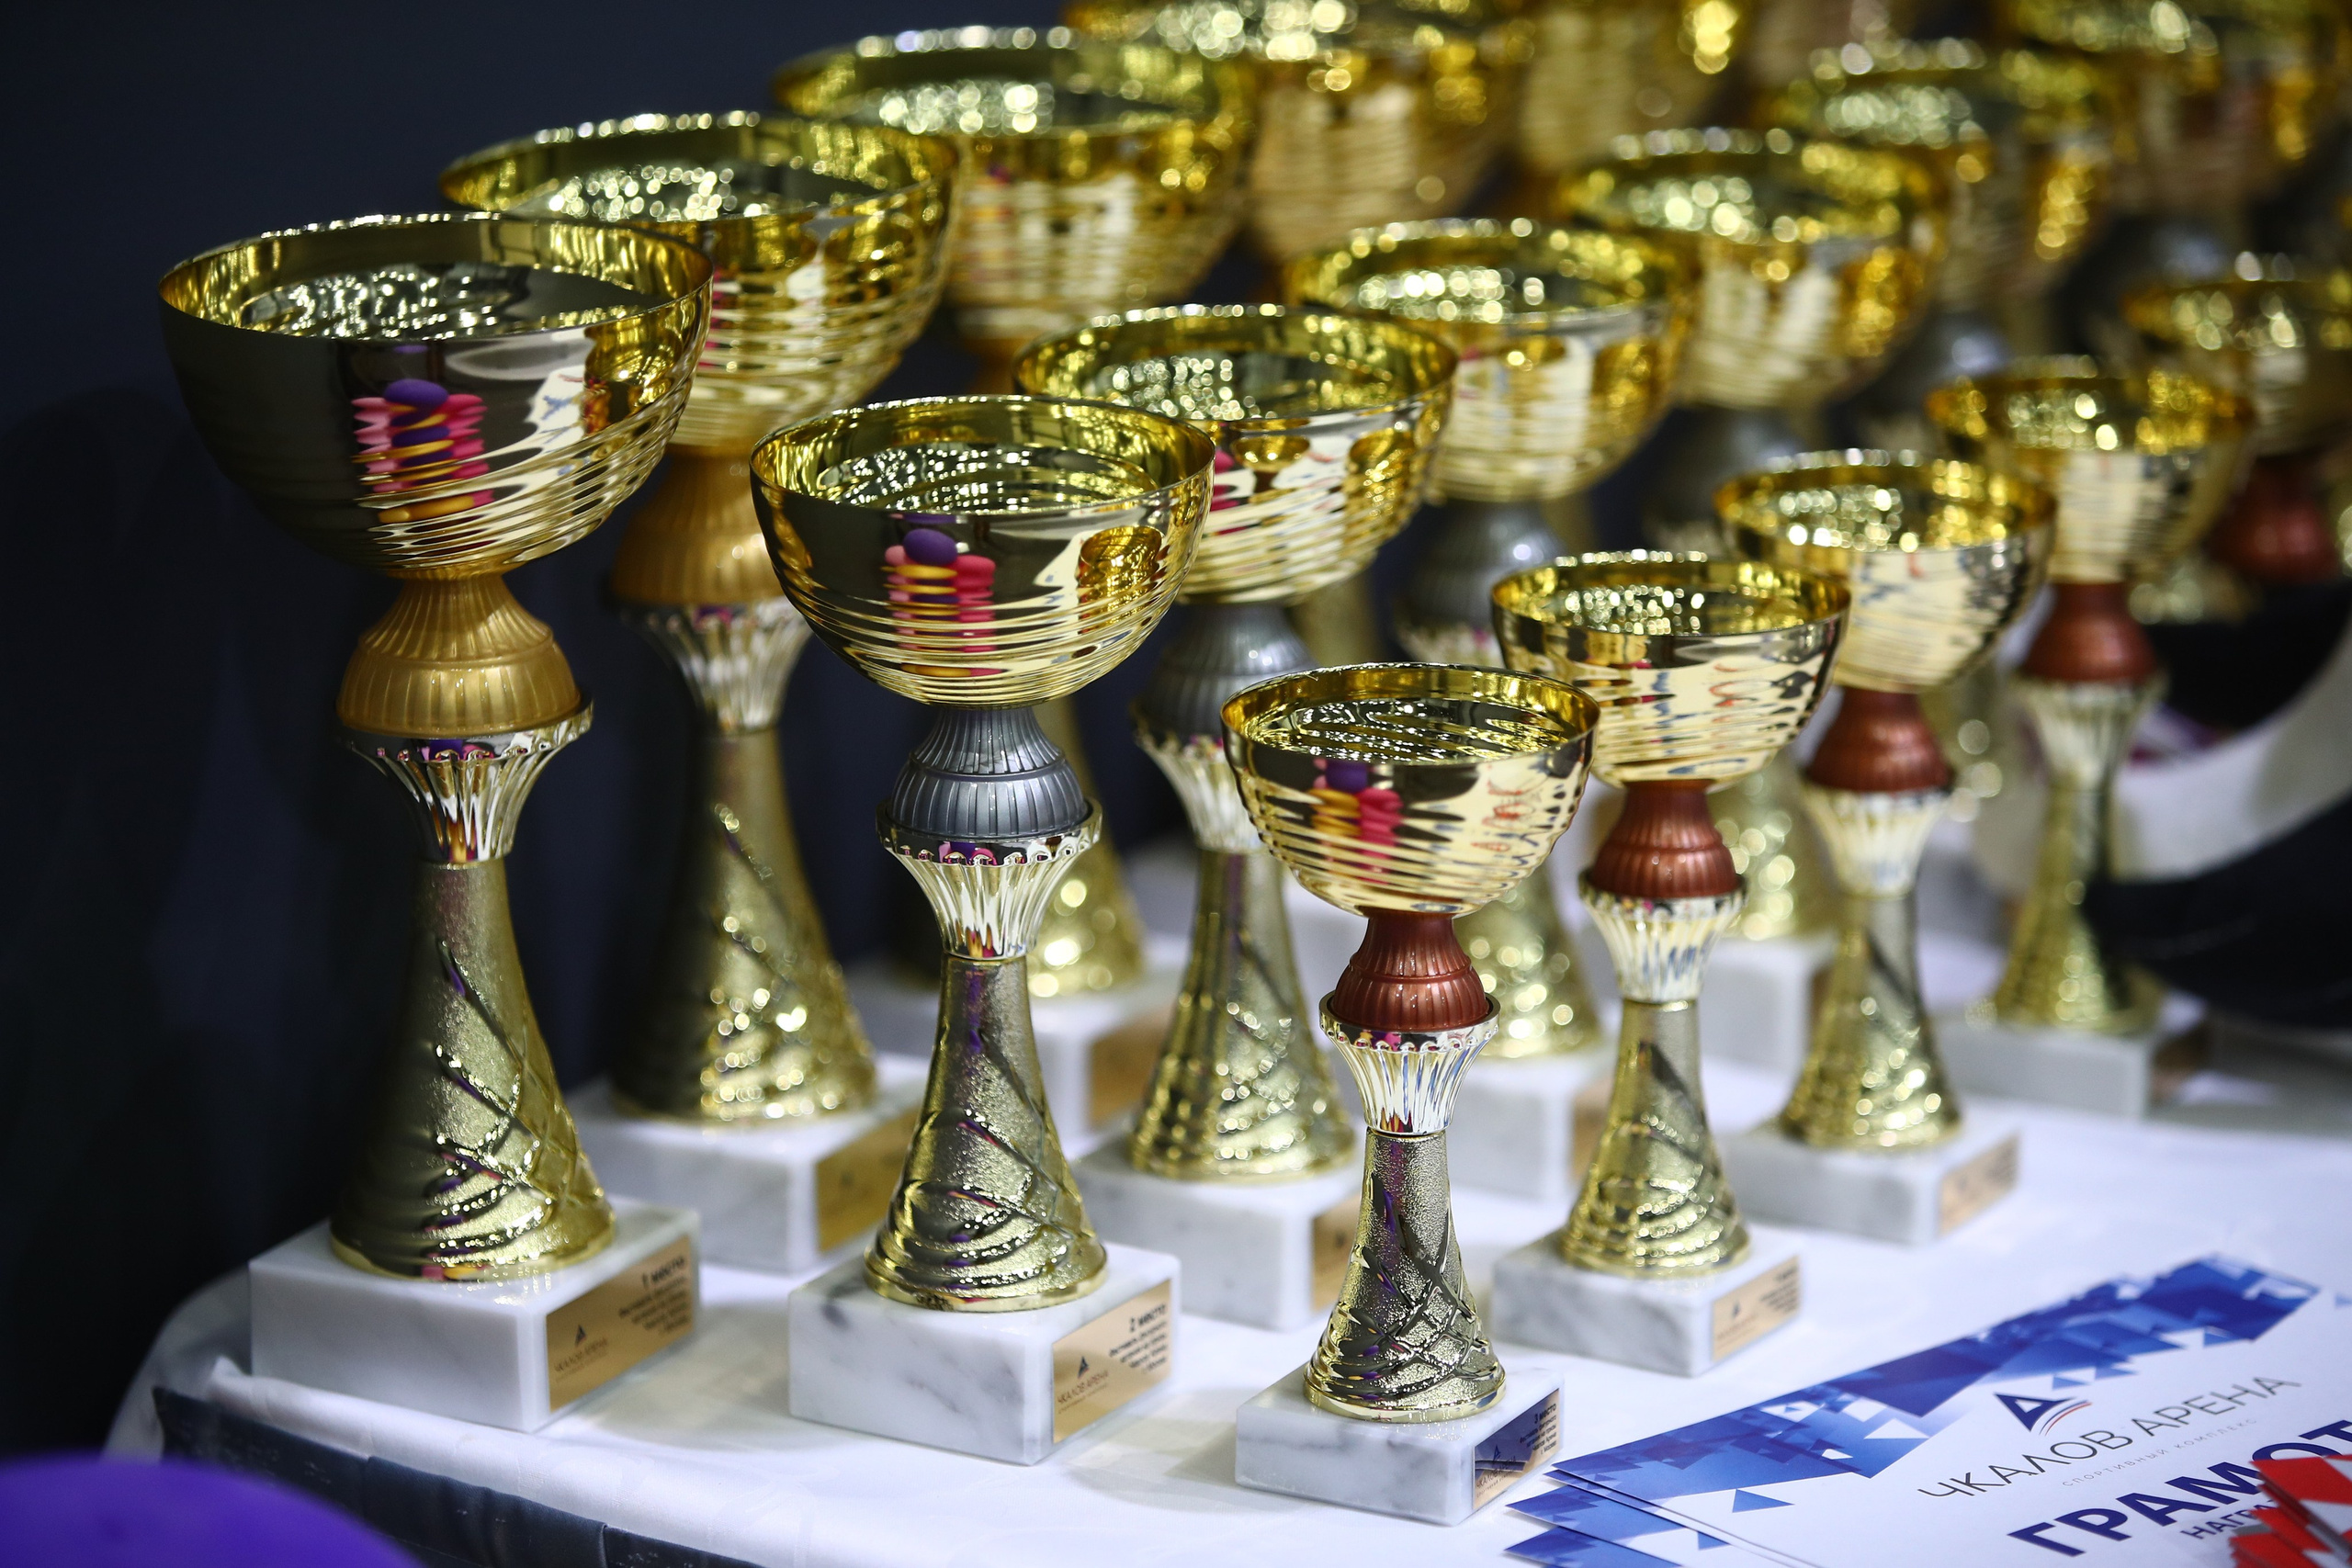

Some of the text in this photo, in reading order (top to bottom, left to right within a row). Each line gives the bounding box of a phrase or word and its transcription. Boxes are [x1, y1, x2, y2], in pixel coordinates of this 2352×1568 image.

[1917, 1377, 2302, 1498] ЧКАЛОВ АРЕНА
[2062, 1417, 2257, 1487] СПОРТИВНЫЙ КОМПЛЕКС
